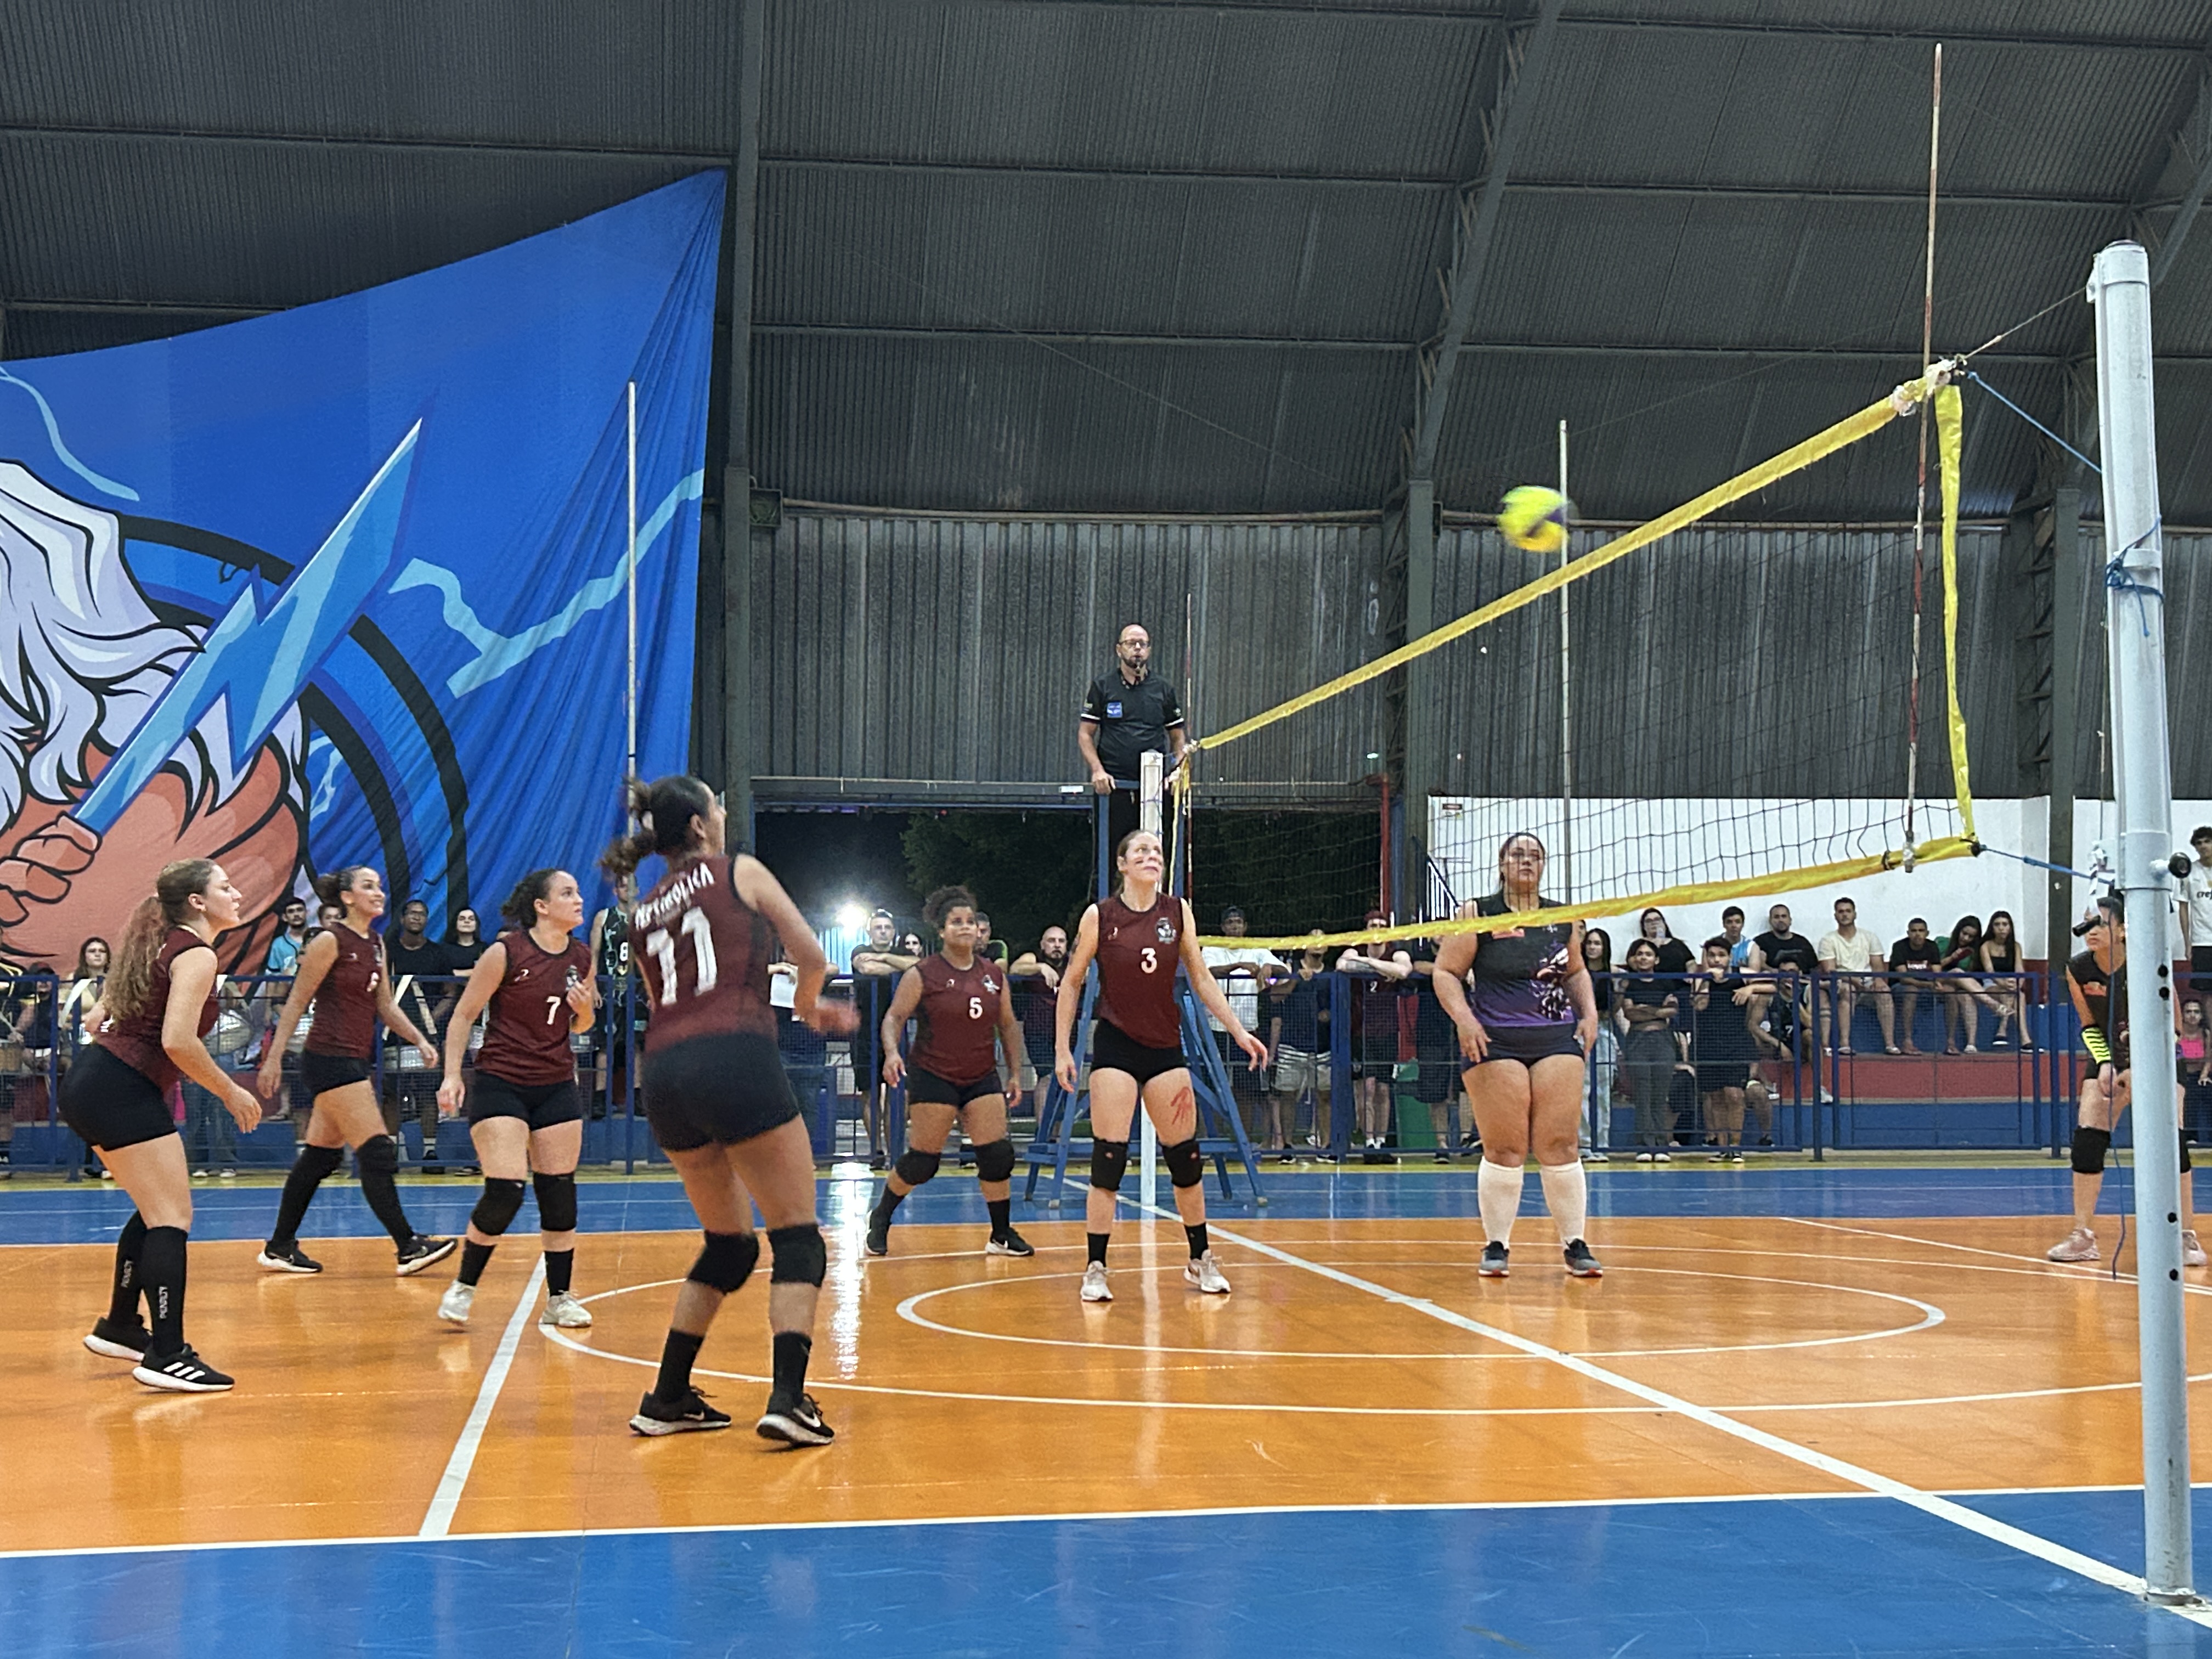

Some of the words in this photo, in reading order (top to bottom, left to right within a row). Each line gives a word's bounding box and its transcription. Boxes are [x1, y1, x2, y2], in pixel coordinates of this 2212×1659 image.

[646, 906, 718, 1006] 11
[1142, 947, 1157, 973] 3
[547, 996, 561, 1025] 7
[969, 997, 983, 1019] 5
